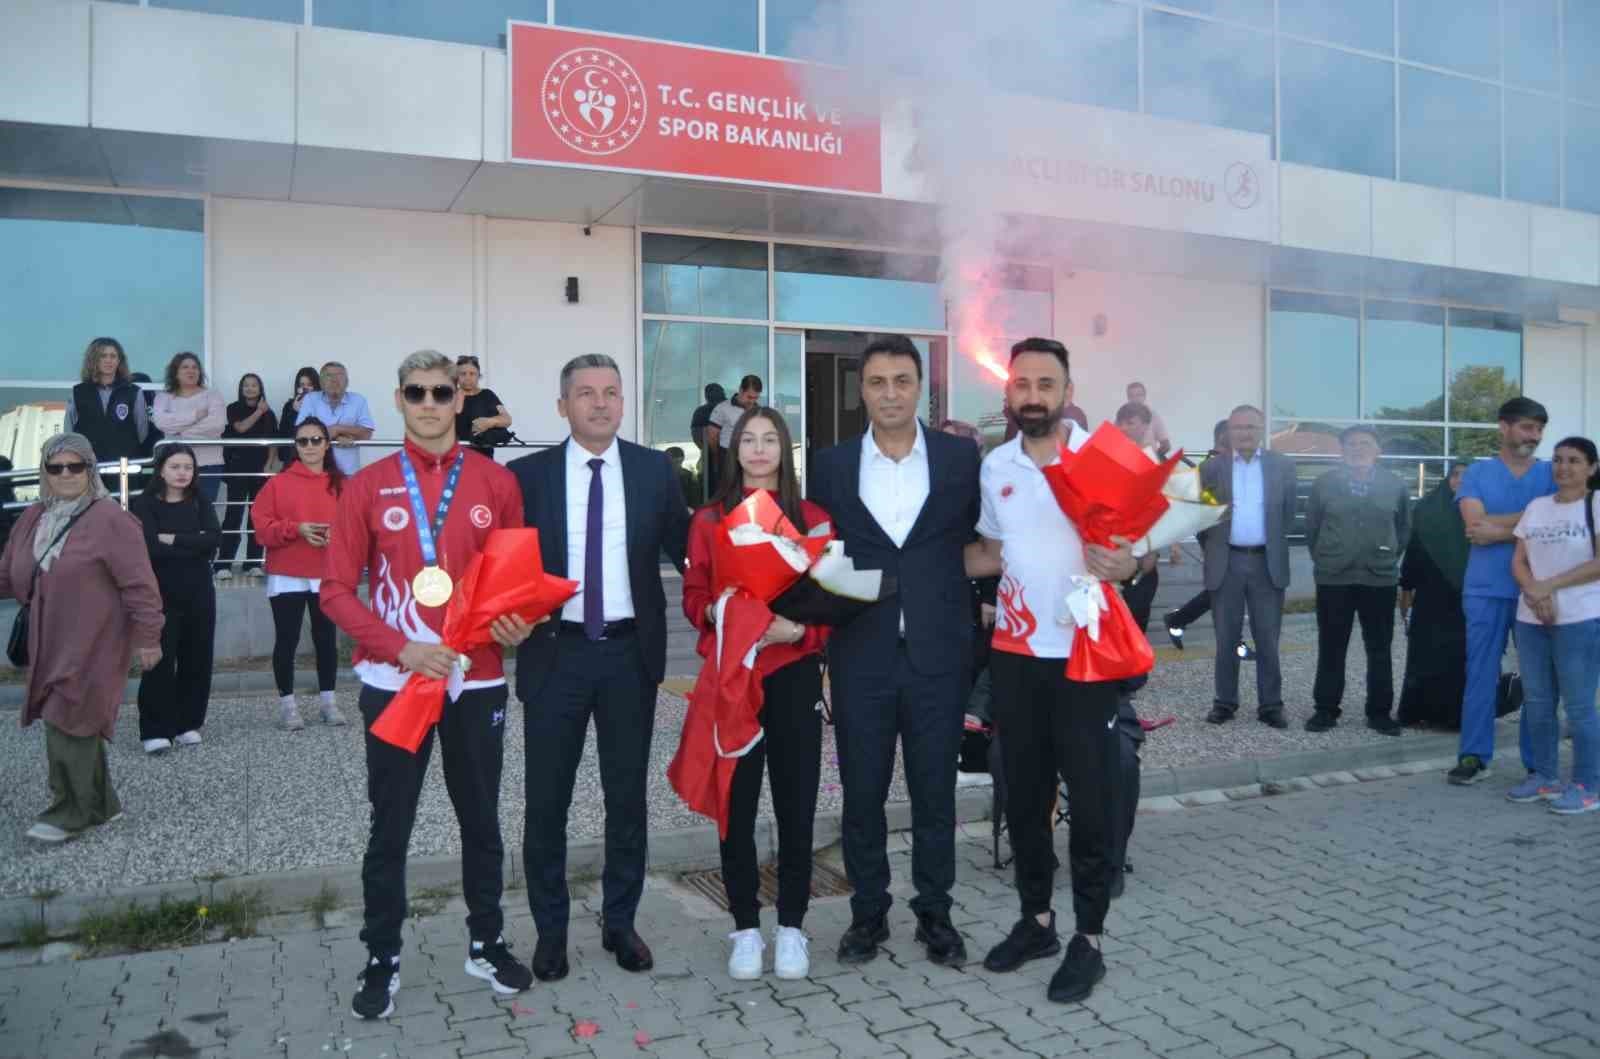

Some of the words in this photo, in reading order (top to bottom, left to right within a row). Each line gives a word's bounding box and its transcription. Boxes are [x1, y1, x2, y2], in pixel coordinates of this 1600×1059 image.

[657, 84, 700, 108] T.C.
[707, 91, 807, 122] GENÇLİK
[815, 104, 841, 125] VE
[658, 116, 719, 142] SPOR
[725, 124, 843, 155] BAKANLIĞI
[1129, 170, 1216, 202] SALONU
